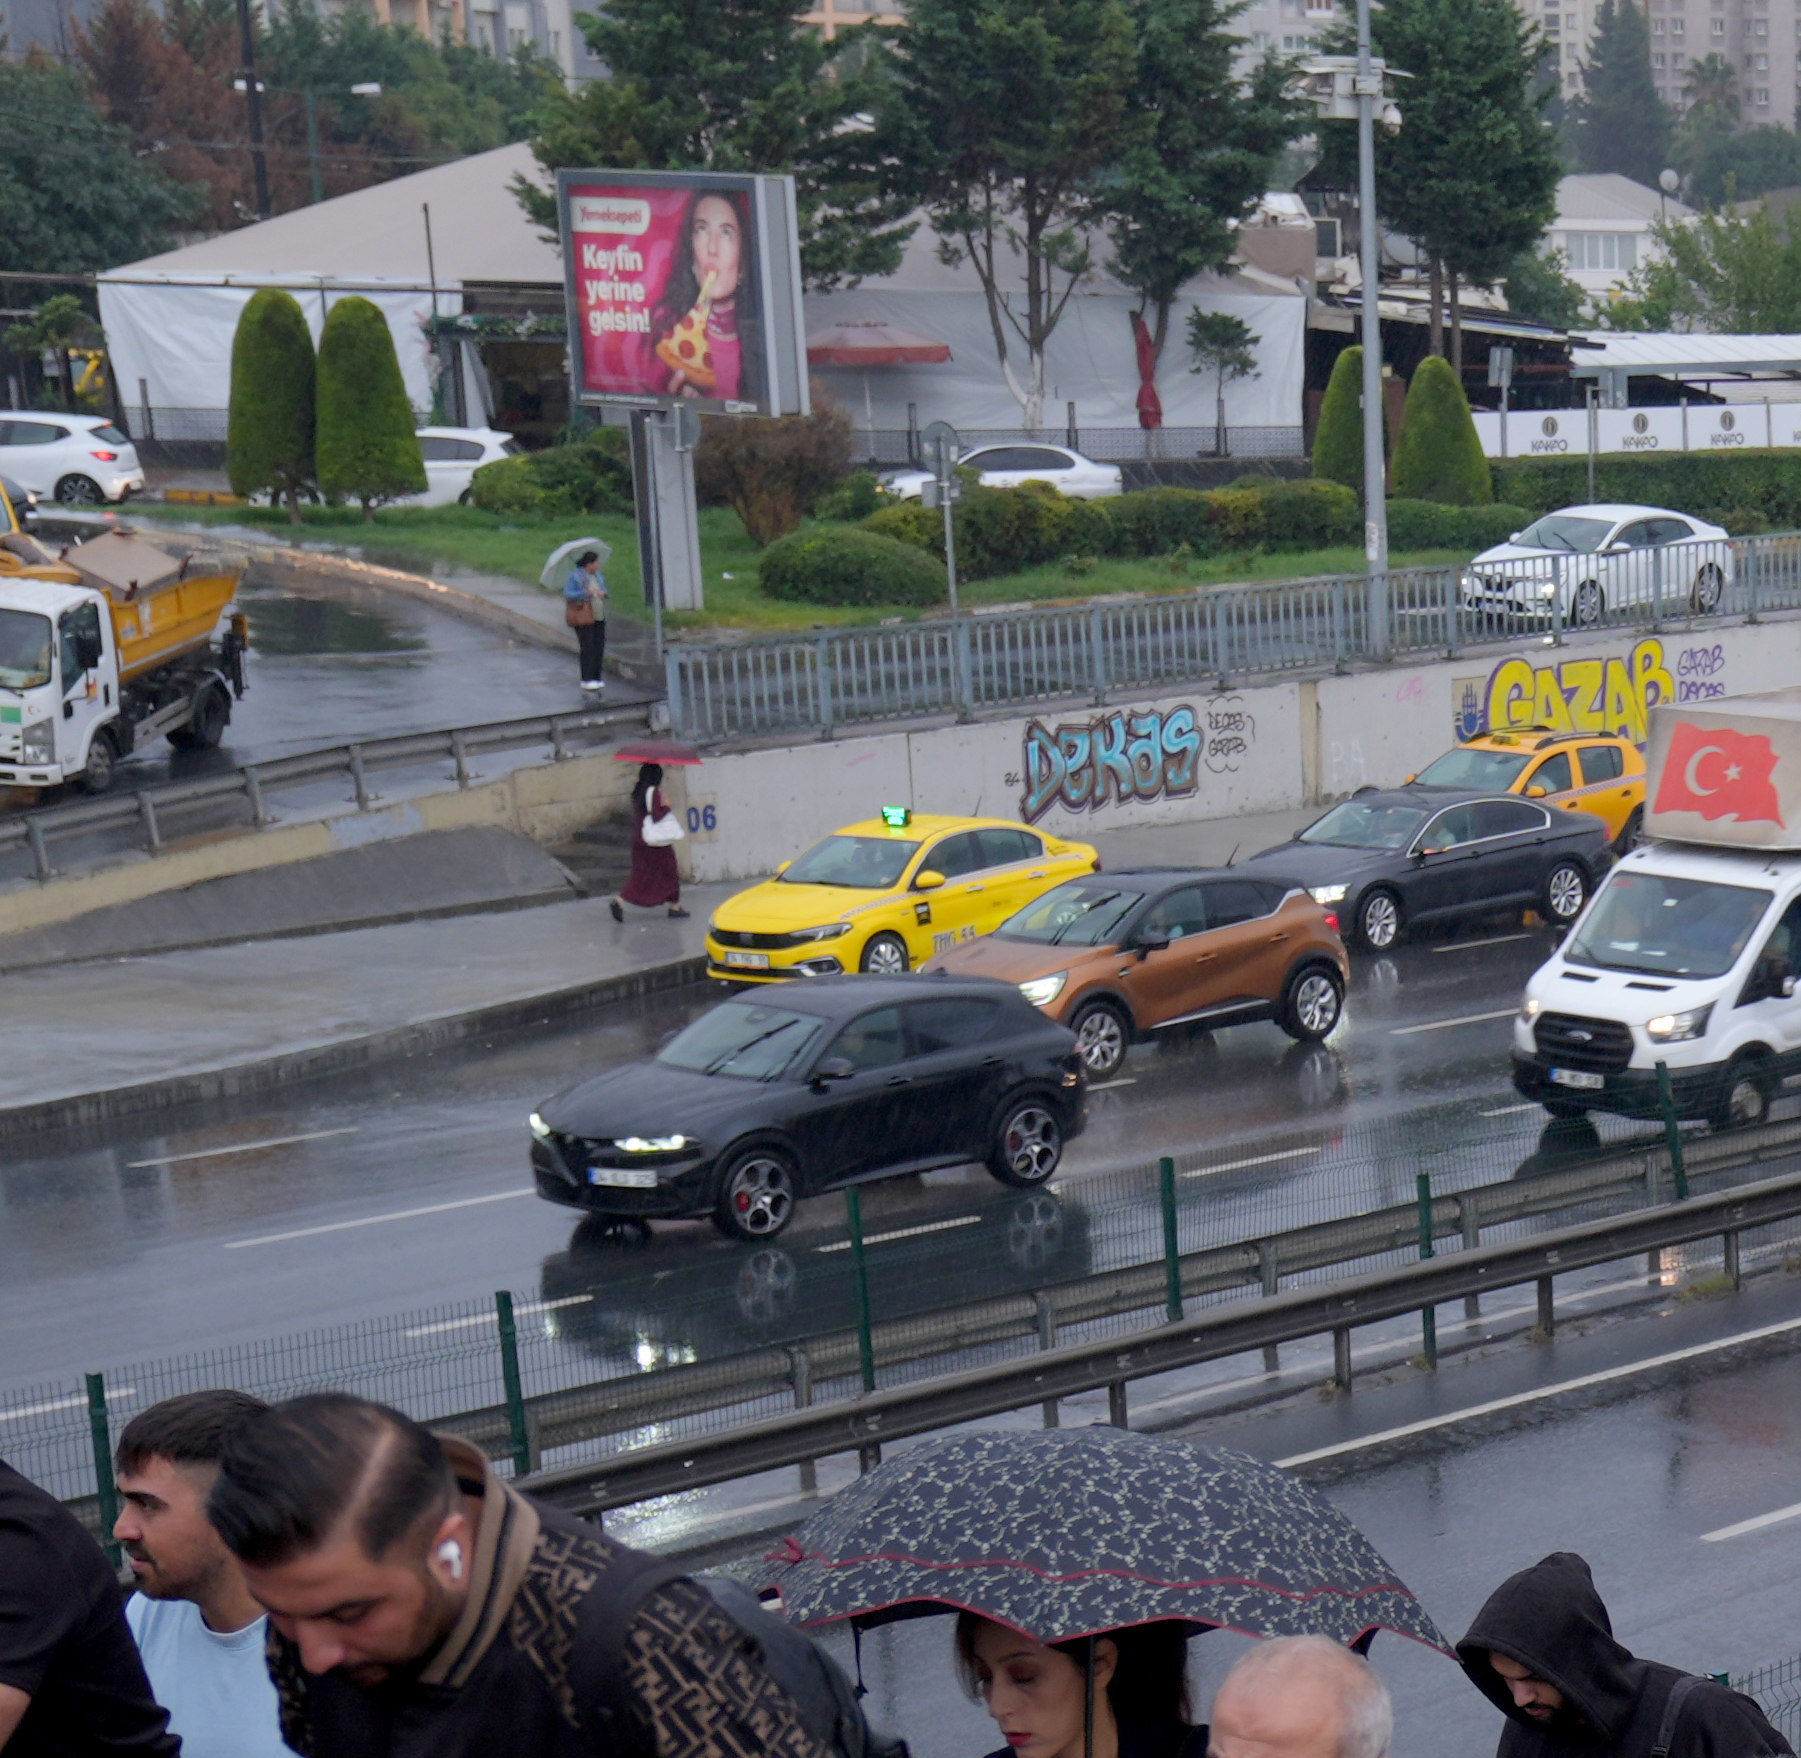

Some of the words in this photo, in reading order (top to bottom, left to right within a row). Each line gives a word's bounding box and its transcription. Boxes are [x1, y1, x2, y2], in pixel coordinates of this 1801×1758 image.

[583, 244, 643, 275] Keyfin
[585, 276, 645, 305] yerine
[588, 306, 650, 336] gelsin!
[1531, 439, 1568, 452] KAKAO
[687, 805, 717, 834] 06
